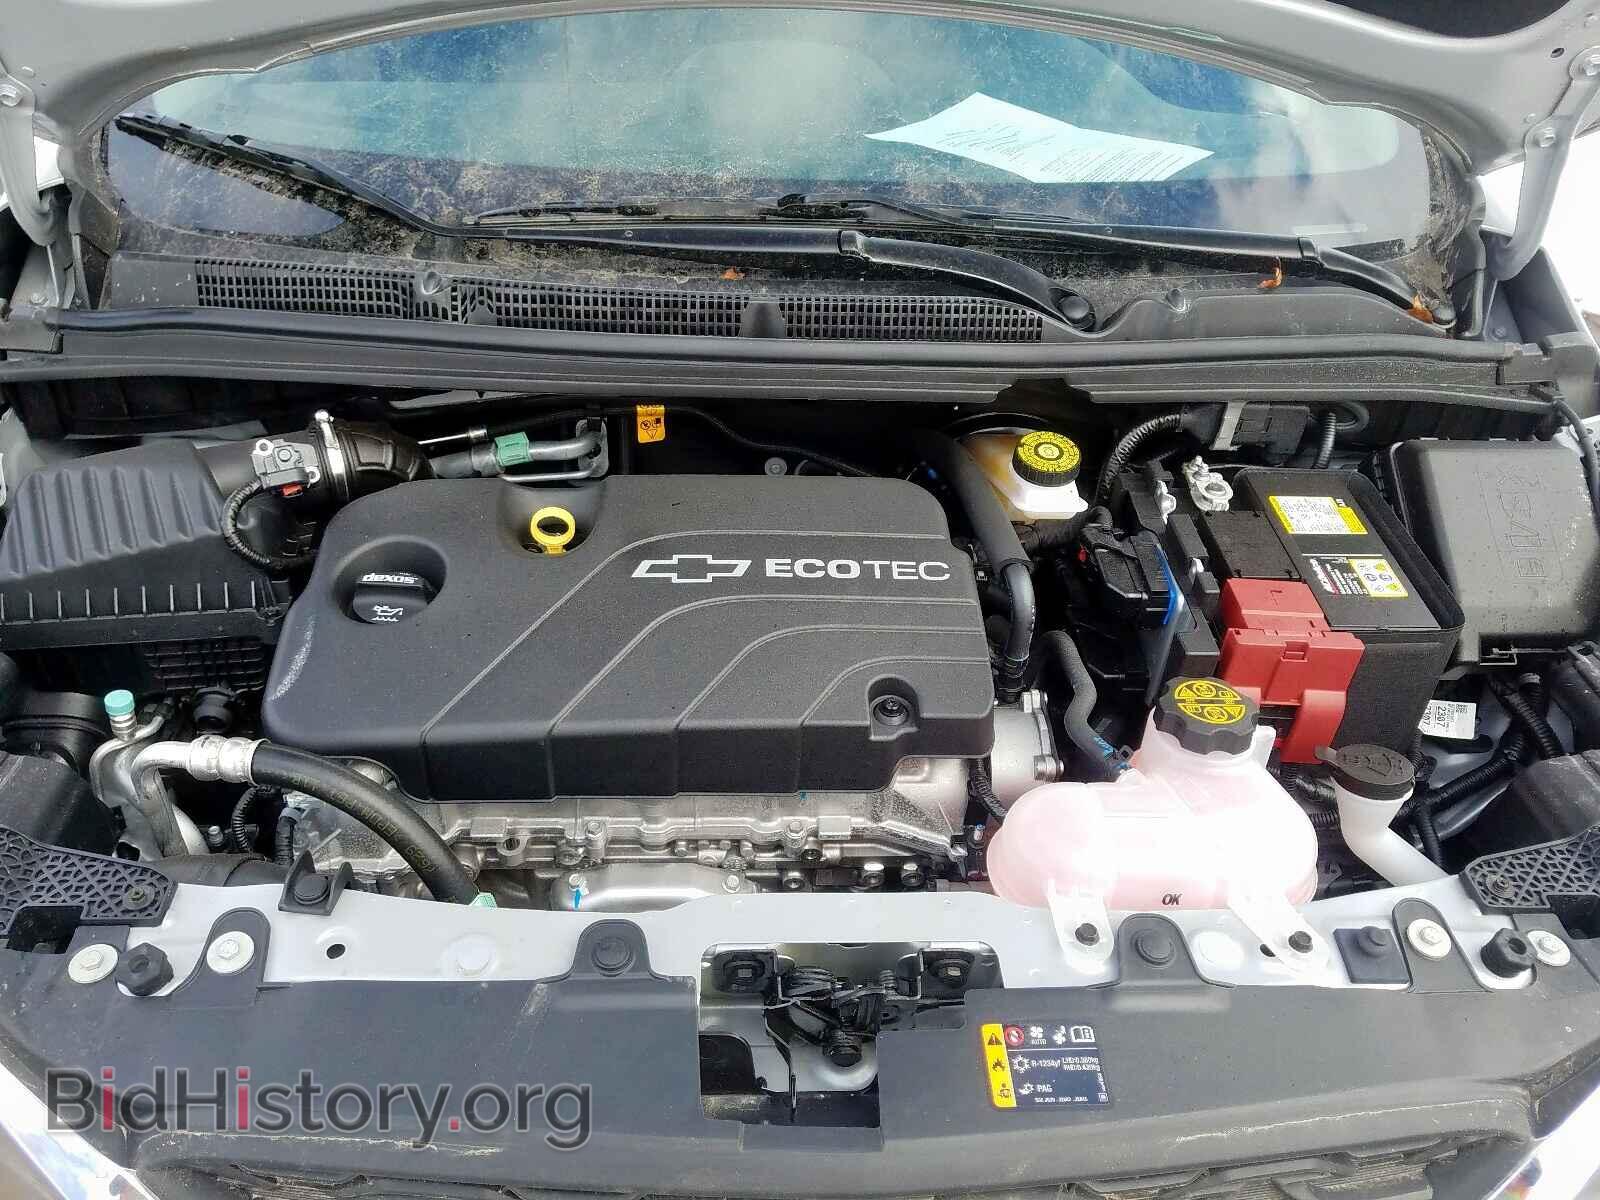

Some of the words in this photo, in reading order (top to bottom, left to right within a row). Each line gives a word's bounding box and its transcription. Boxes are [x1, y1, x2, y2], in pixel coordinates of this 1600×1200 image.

[765, 558, 951, 581] ECOTEC
[362, 572, 418, 584] dexos
[1161, 893, 1183, 906] OK
[1037, 1084, 1053, 1093] PAG
